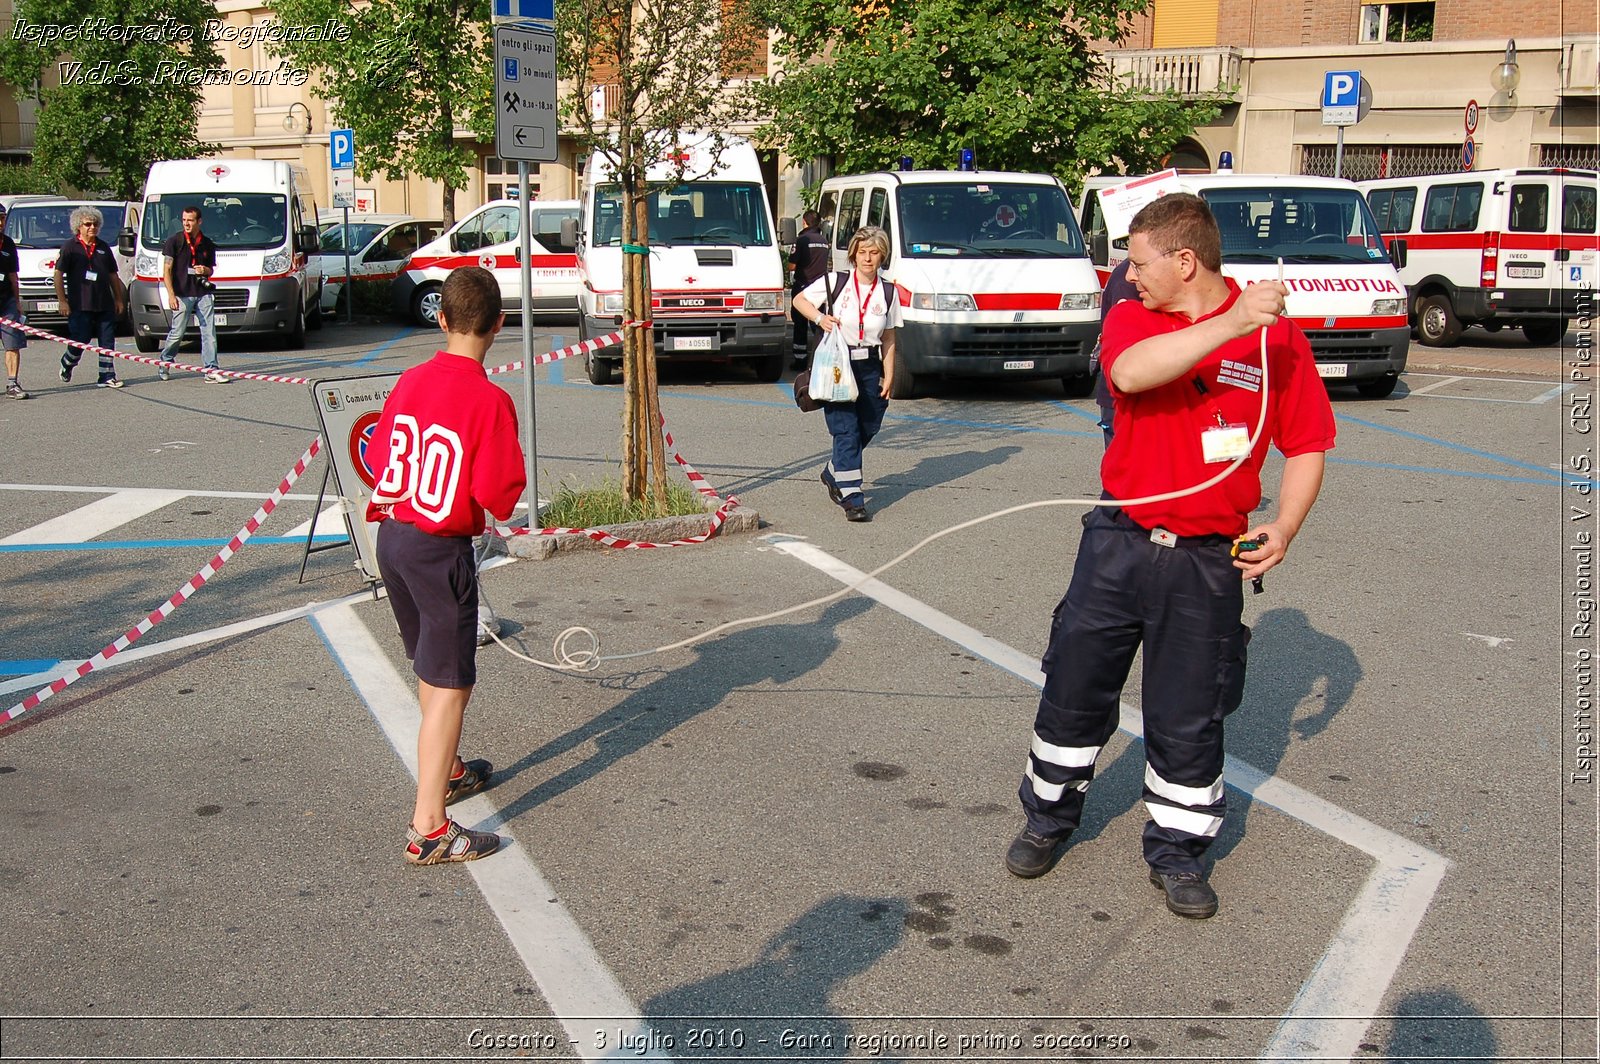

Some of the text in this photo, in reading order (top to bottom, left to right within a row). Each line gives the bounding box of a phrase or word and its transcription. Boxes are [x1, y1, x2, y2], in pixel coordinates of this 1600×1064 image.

[501, 38, 553, 54] entro gli spazi
[523, 67, 553, 79] 30 minuti
[1330, 74, 1354, 104] P
[1468, 107, 1476, 127] 30
[334, 134, 349, 164] P
[537, 269, 566, 277] CROCE
[345, 394, 372, 403] Comune
[374, 391, 381, 400] di
[371, 413, 464, 523] 30
